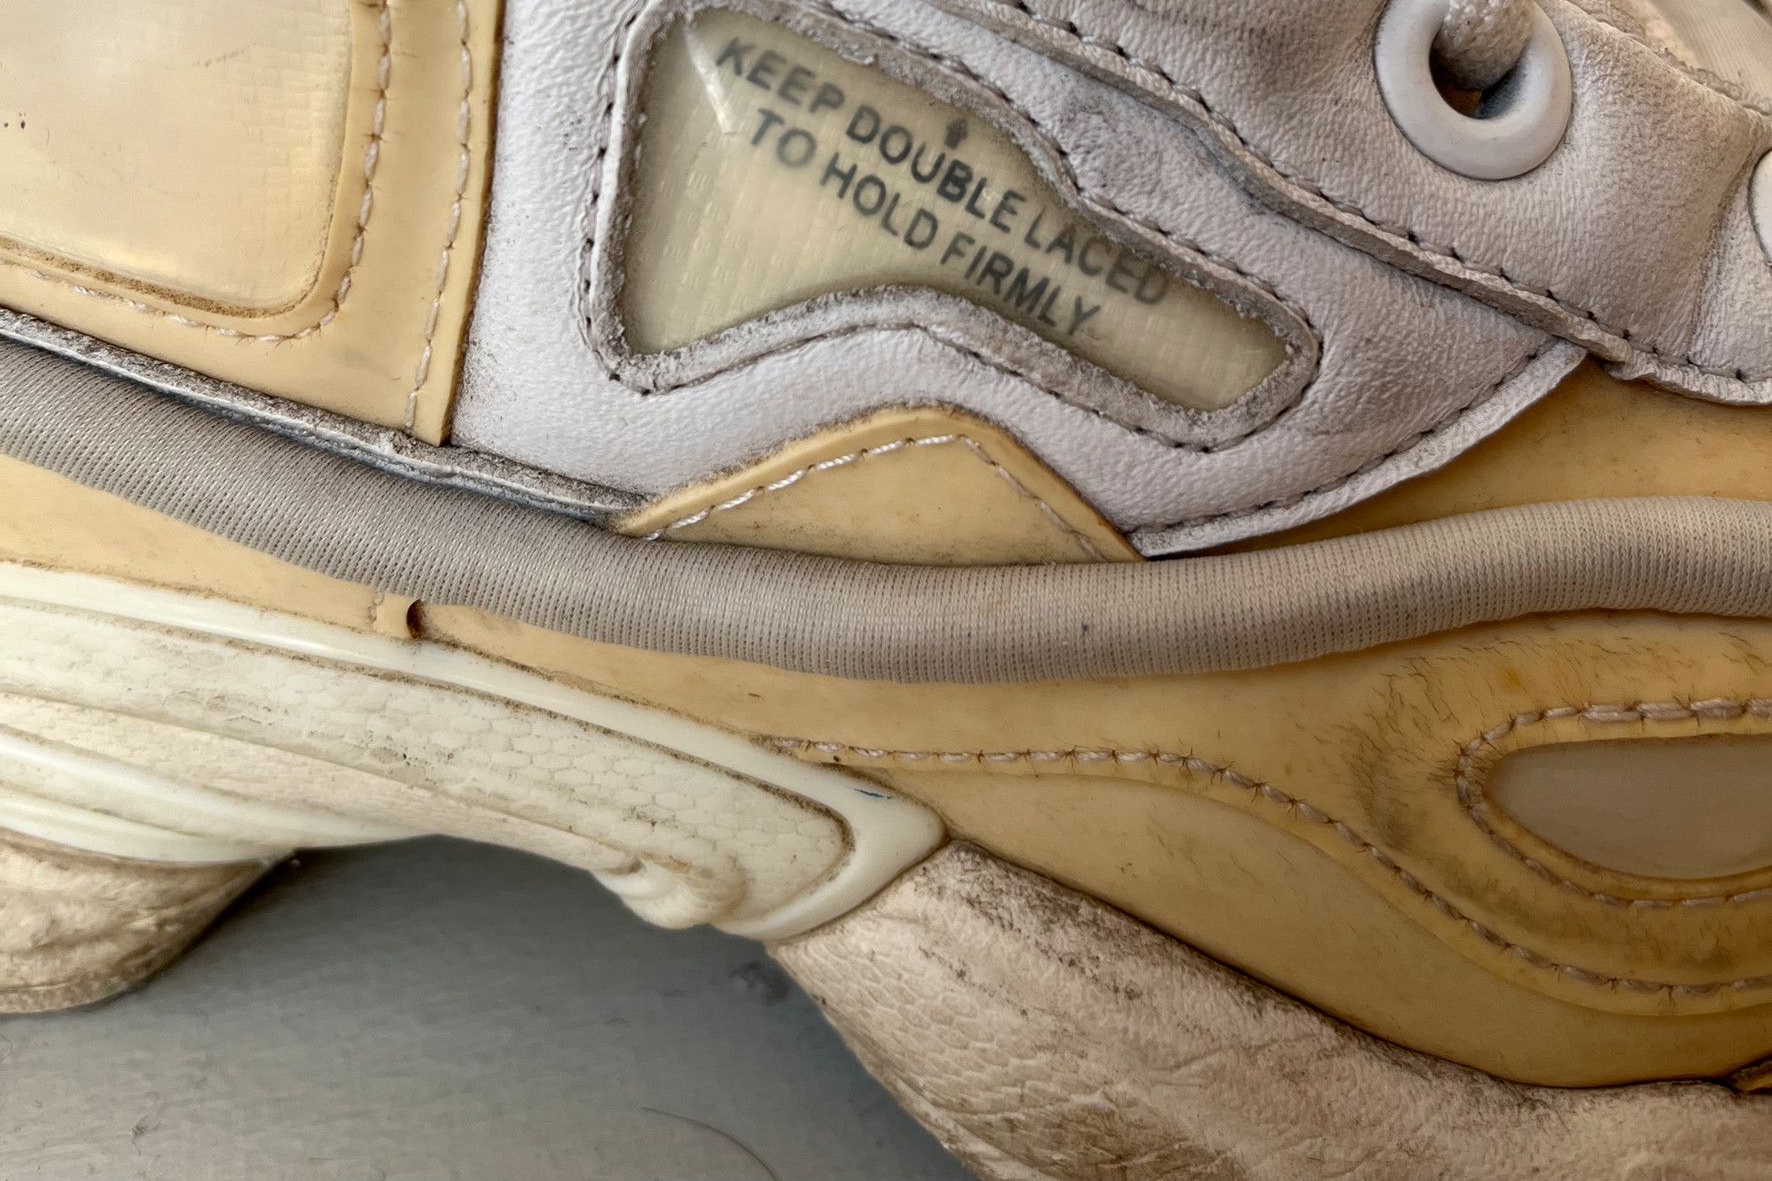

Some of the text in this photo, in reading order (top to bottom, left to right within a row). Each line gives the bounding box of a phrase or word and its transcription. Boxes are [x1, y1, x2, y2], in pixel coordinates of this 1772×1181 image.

[716, 37, 1169, 305] KEEP DOUBLE LACED
[749, 107, 1100, 337] TO HOLD FIRMLY
